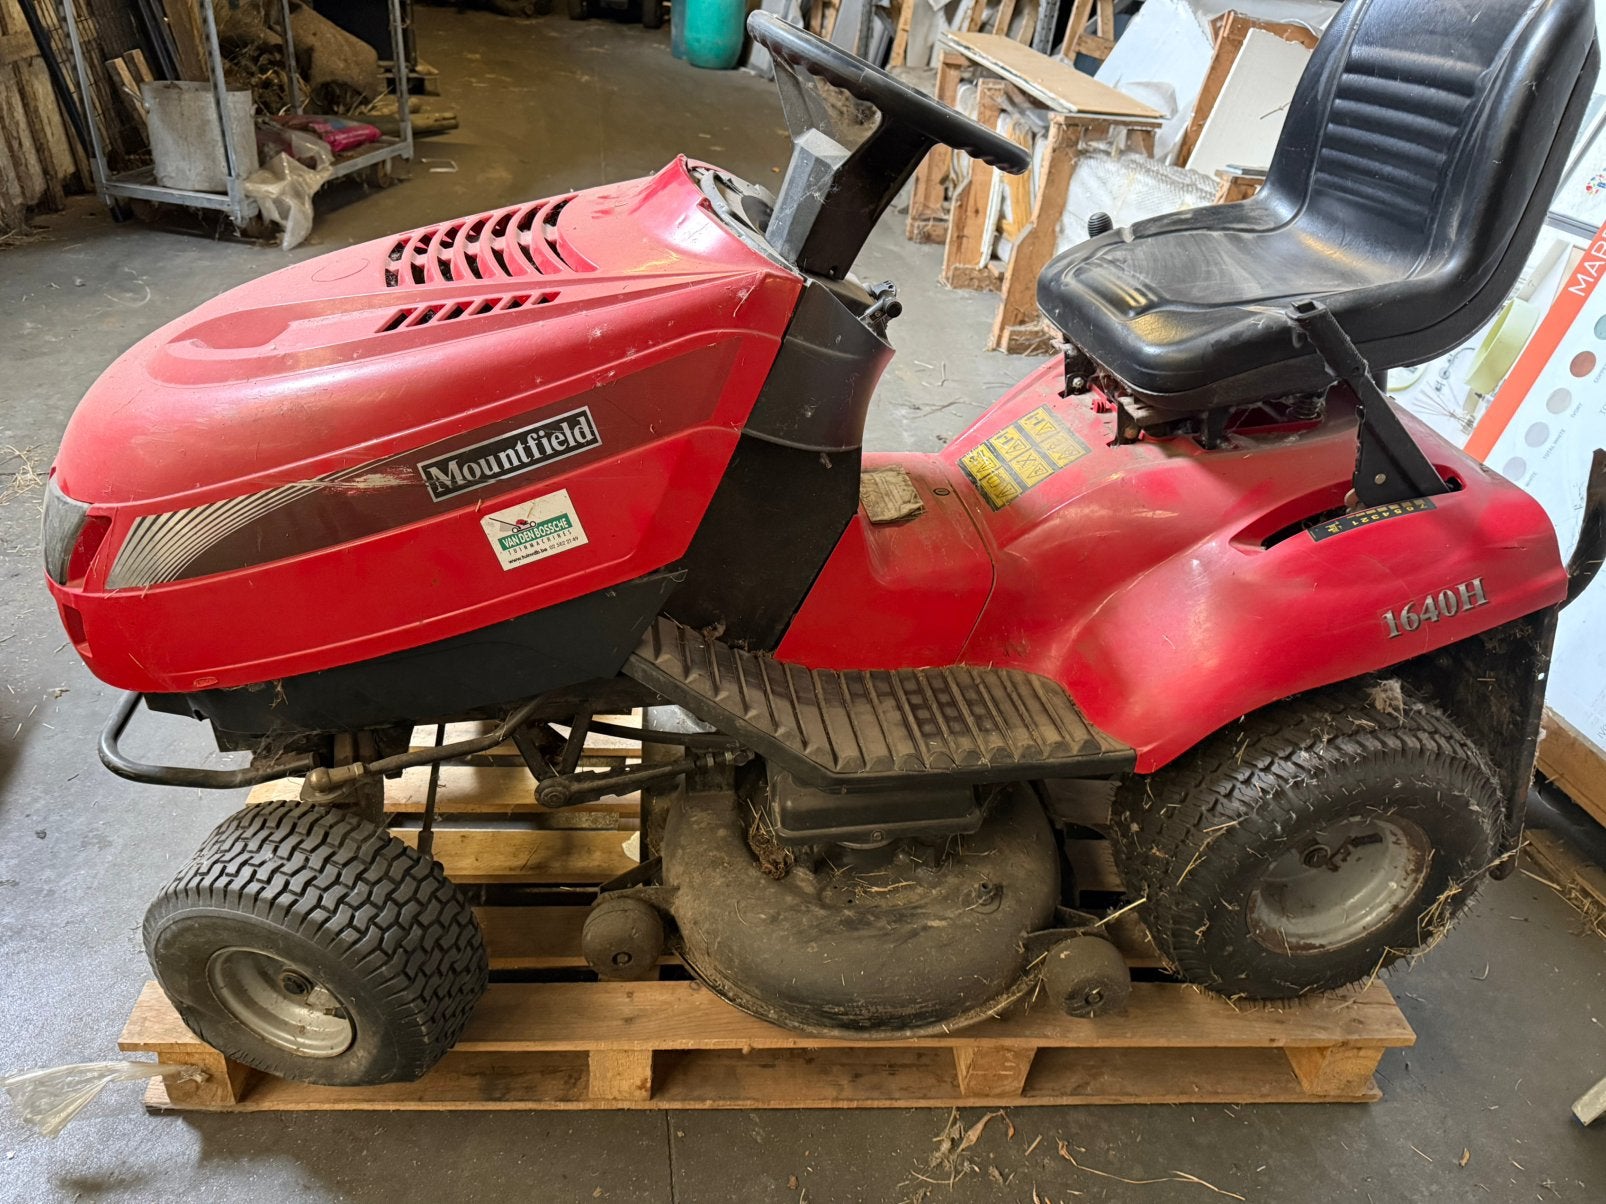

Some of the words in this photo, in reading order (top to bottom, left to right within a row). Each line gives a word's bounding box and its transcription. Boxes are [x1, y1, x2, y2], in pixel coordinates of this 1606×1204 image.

[427, 415, 595, 493] Mountfield
[501, 534, 521, 548] VAN
[519, 529, 535, 543] DEN
[534, 518, 569, 539] BOSSCHE
[508, 529, 572, 556] TUINMACHINES
[1382, 577, 1489, 639] 1640H
